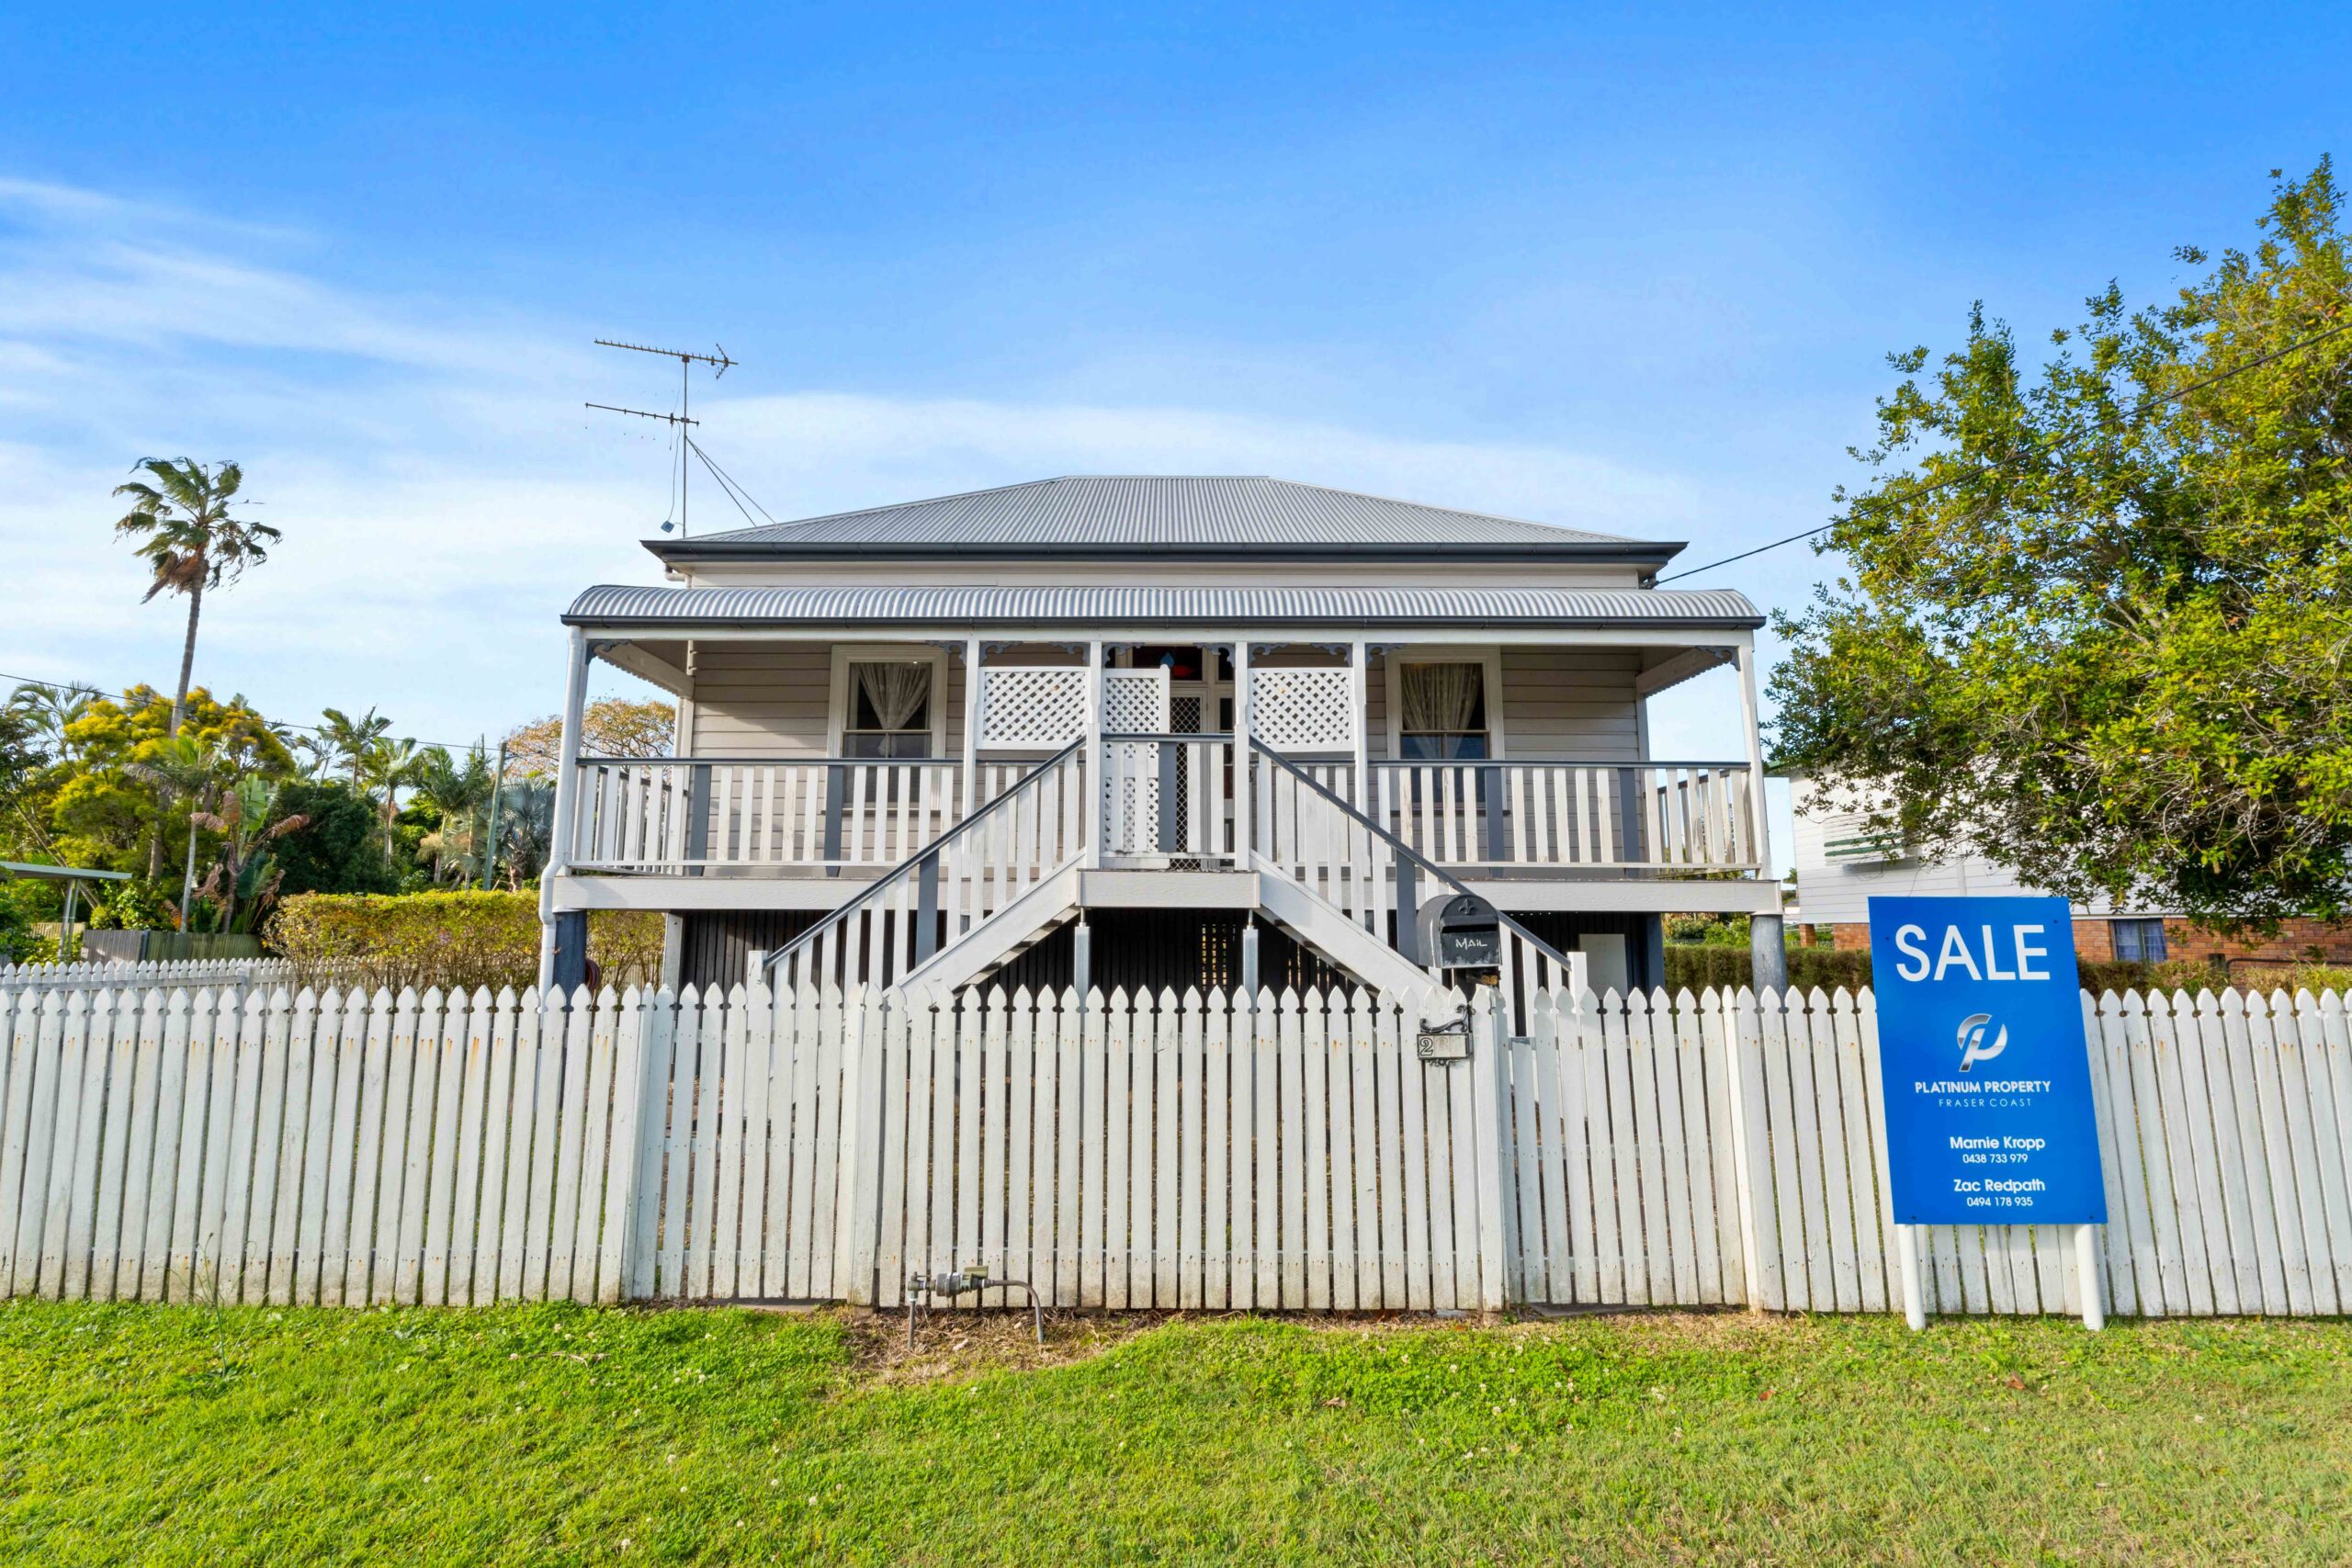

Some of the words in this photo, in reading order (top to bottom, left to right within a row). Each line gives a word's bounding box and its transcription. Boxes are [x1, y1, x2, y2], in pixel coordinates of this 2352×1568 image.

[1894, 923, 2051, 982] SALE
[1915, 1081, 1982, 1094] PLATINUM
[1984, 1080, 2052, 1093] PROPERTY
[1939, 1099, 1984, 1108] FRASER
[1989, 1098, 2031, 1108] COAST
[1950, 1136, 2000, 1149] Marnie
[2003, 1135, 2046, 1151] Kropp
[1962, 1154, 1987, 1164] 0438
[1989, 1154, 2007, 1164] 733
[2009, 1153, 2029, 1164] 979
[1953, 1179, 1982, 1192] Zac
[1984, 1179, 2046, 1194] Redpath
[1966, 1197, 1992, 1207] 0494
[1995, 1197, 2012, 1207] 178
[2014, 1196, 2033, 1207] 935
